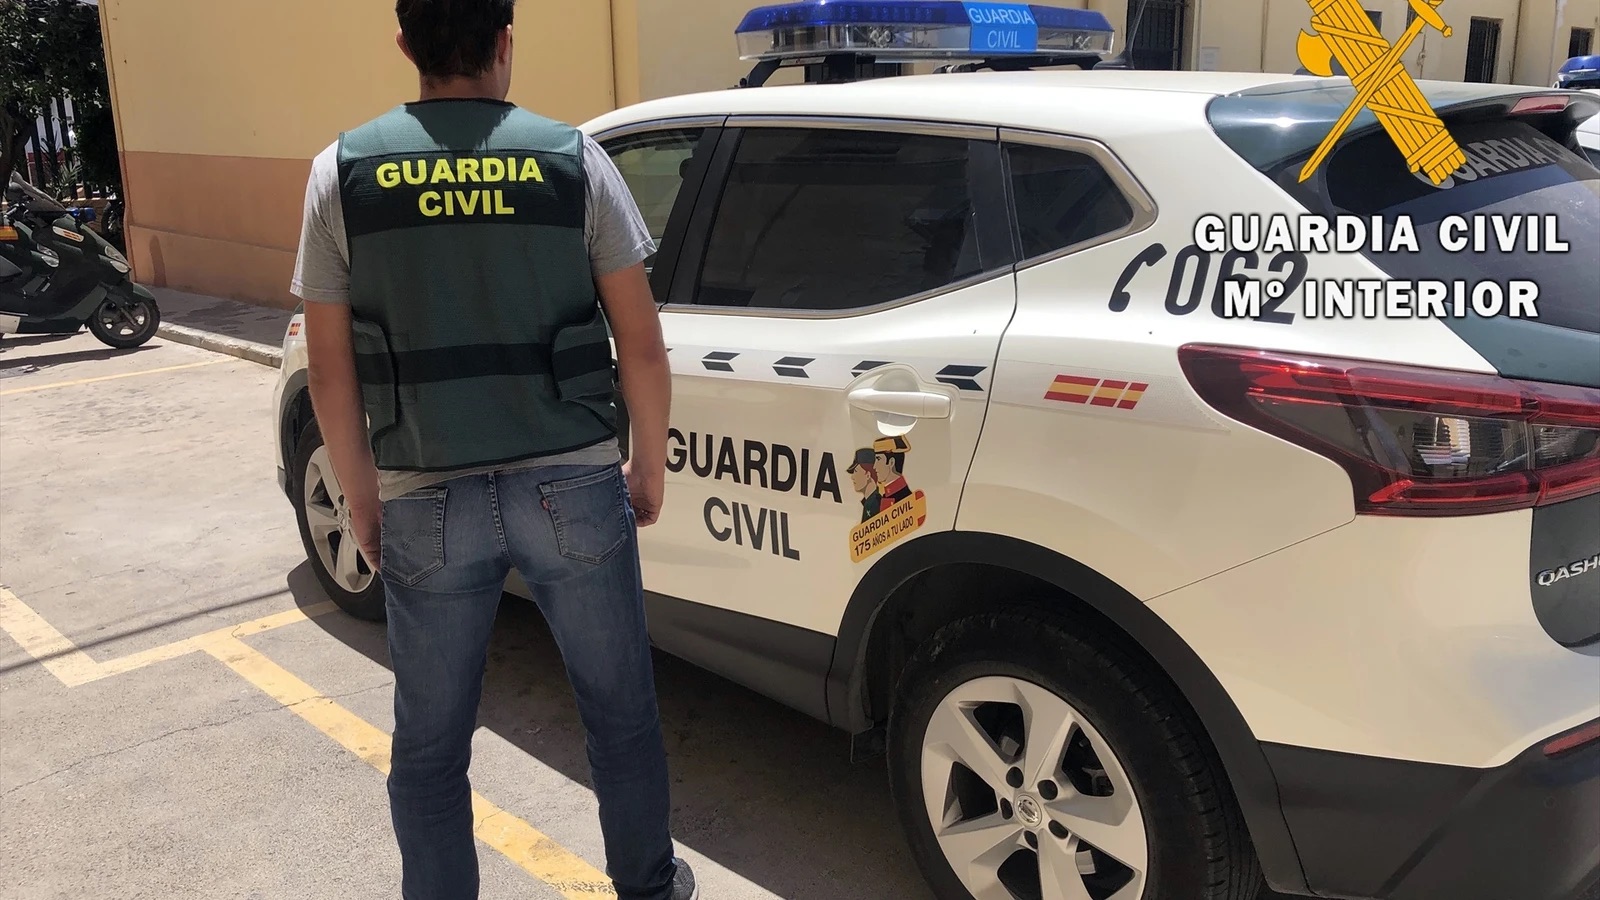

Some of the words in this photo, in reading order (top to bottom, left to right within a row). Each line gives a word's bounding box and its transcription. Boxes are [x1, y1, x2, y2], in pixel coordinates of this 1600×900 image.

[968, 8, 1035, 24] GUARDIA
[987, 30, 1021, 48] CIVIL
[376, 157, 545, 188] GUARDIA
[418, 189, 515, 217] CIVIL
[1164, 243, 1309, 325] 062
[665, 427, 843, 504] GUARDIA
[703, 496, 800, 561] CIVIL
[852, 514, 889, 542] GUARDIA
[891, 500, 913, 520] CIVIL
[854, 538, 871, 557] 175
[886, 530, 891, 538] A
[891, 524, 899, 536] TU
[900, 515, 914, 532] LADO
[1538, 555, 1600, 586] QASH
